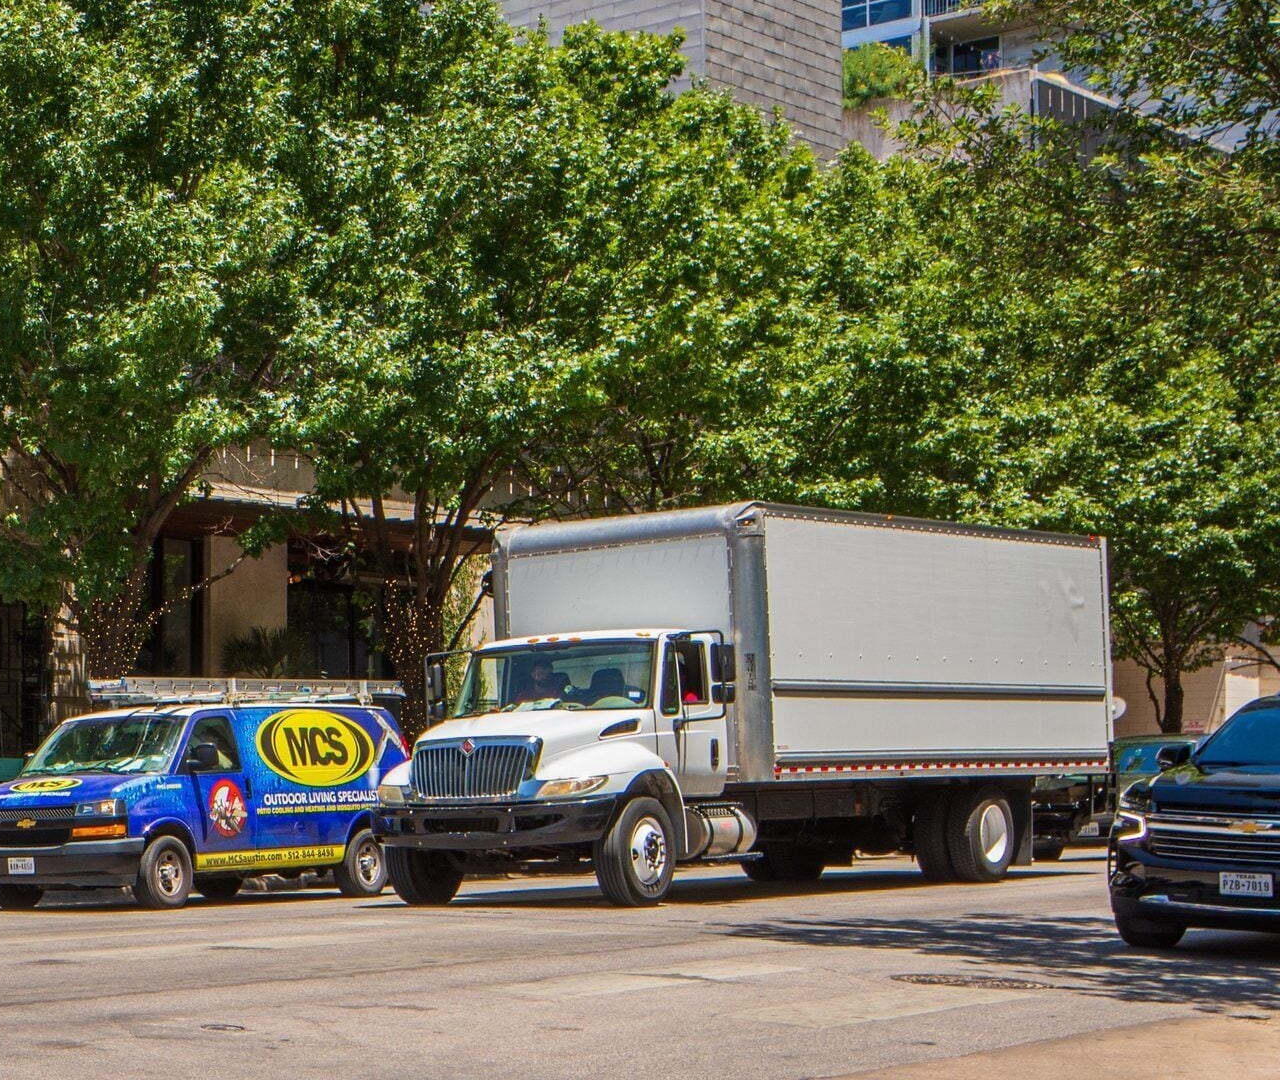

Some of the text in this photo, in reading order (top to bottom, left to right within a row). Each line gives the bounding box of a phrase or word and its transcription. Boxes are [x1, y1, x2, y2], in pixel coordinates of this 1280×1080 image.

[283, 727, 348, 767] MCS
[264, 793, 308, 805] OUTDOOR
[309, 792, 336, 804] LIVING
[206, 848, 335, 865] www.MCSaustin.com 512-844-8498
